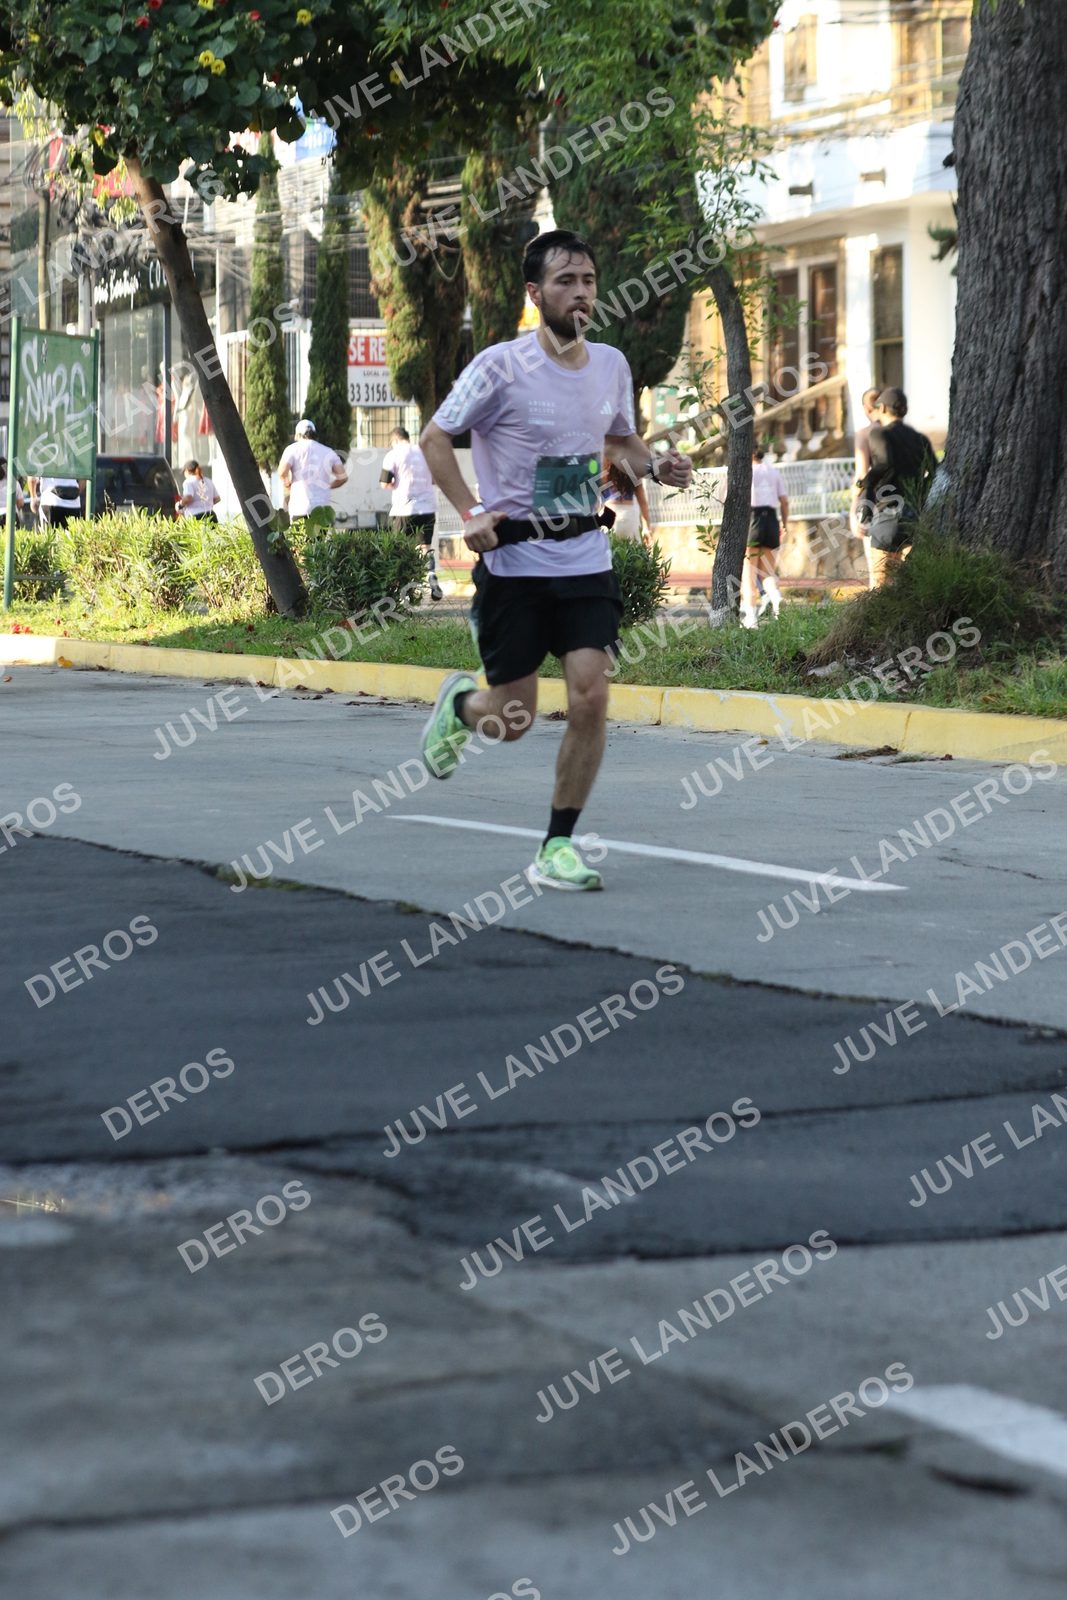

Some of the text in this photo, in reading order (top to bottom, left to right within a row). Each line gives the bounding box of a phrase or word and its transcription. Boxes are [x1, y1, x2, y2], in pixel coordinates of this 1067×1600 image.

[349, 336, 365, 362] SE
[350, 383, 361, 402] 33
[365, 383, 387, 402] 3156
